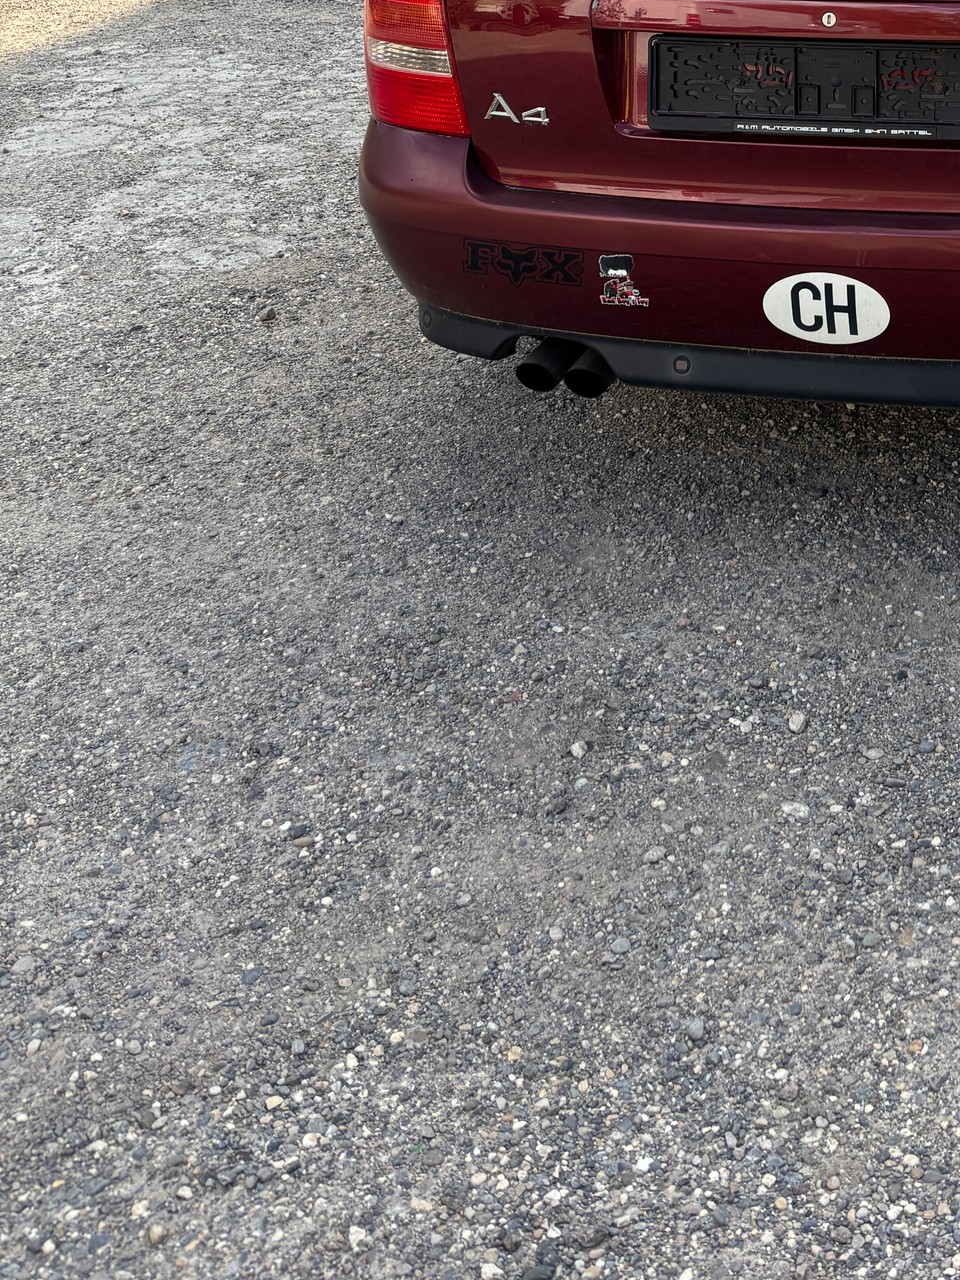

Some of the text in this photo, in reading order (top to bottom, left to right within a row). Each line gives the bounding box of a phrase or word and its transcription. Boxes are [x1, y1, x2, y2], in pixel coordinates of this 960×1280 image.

[483, 92, 550, 126] A4
[761, 125, 828, 133] AUTOMOBILE
[790, 281, 859, 336] CH
